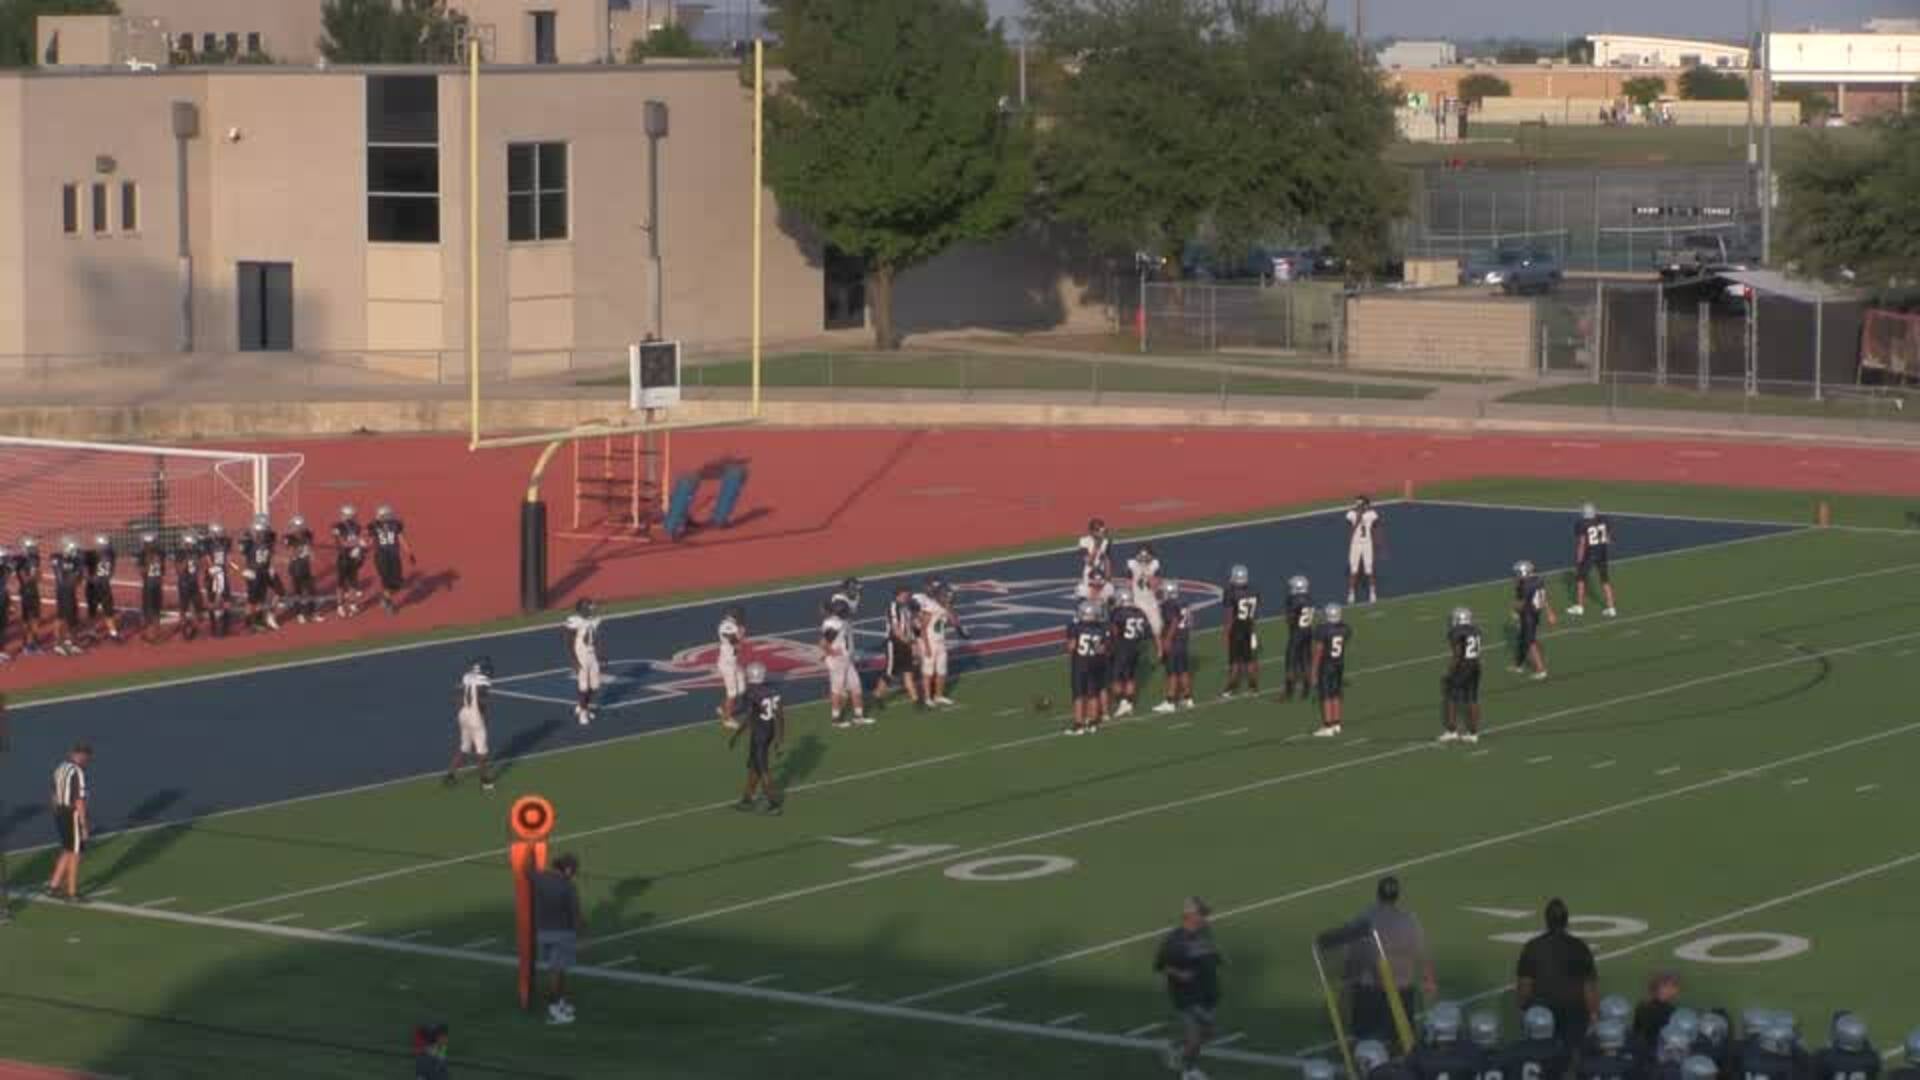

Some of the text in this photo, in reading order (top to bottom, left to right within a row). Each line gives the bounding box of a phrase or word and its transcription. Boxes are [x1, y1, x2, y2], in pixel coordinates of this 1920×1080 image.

[1588, 524, 1607, 544] 27
[1238, 597, 1257, 619] 57
[1331, 636, 1344, 657] 5
